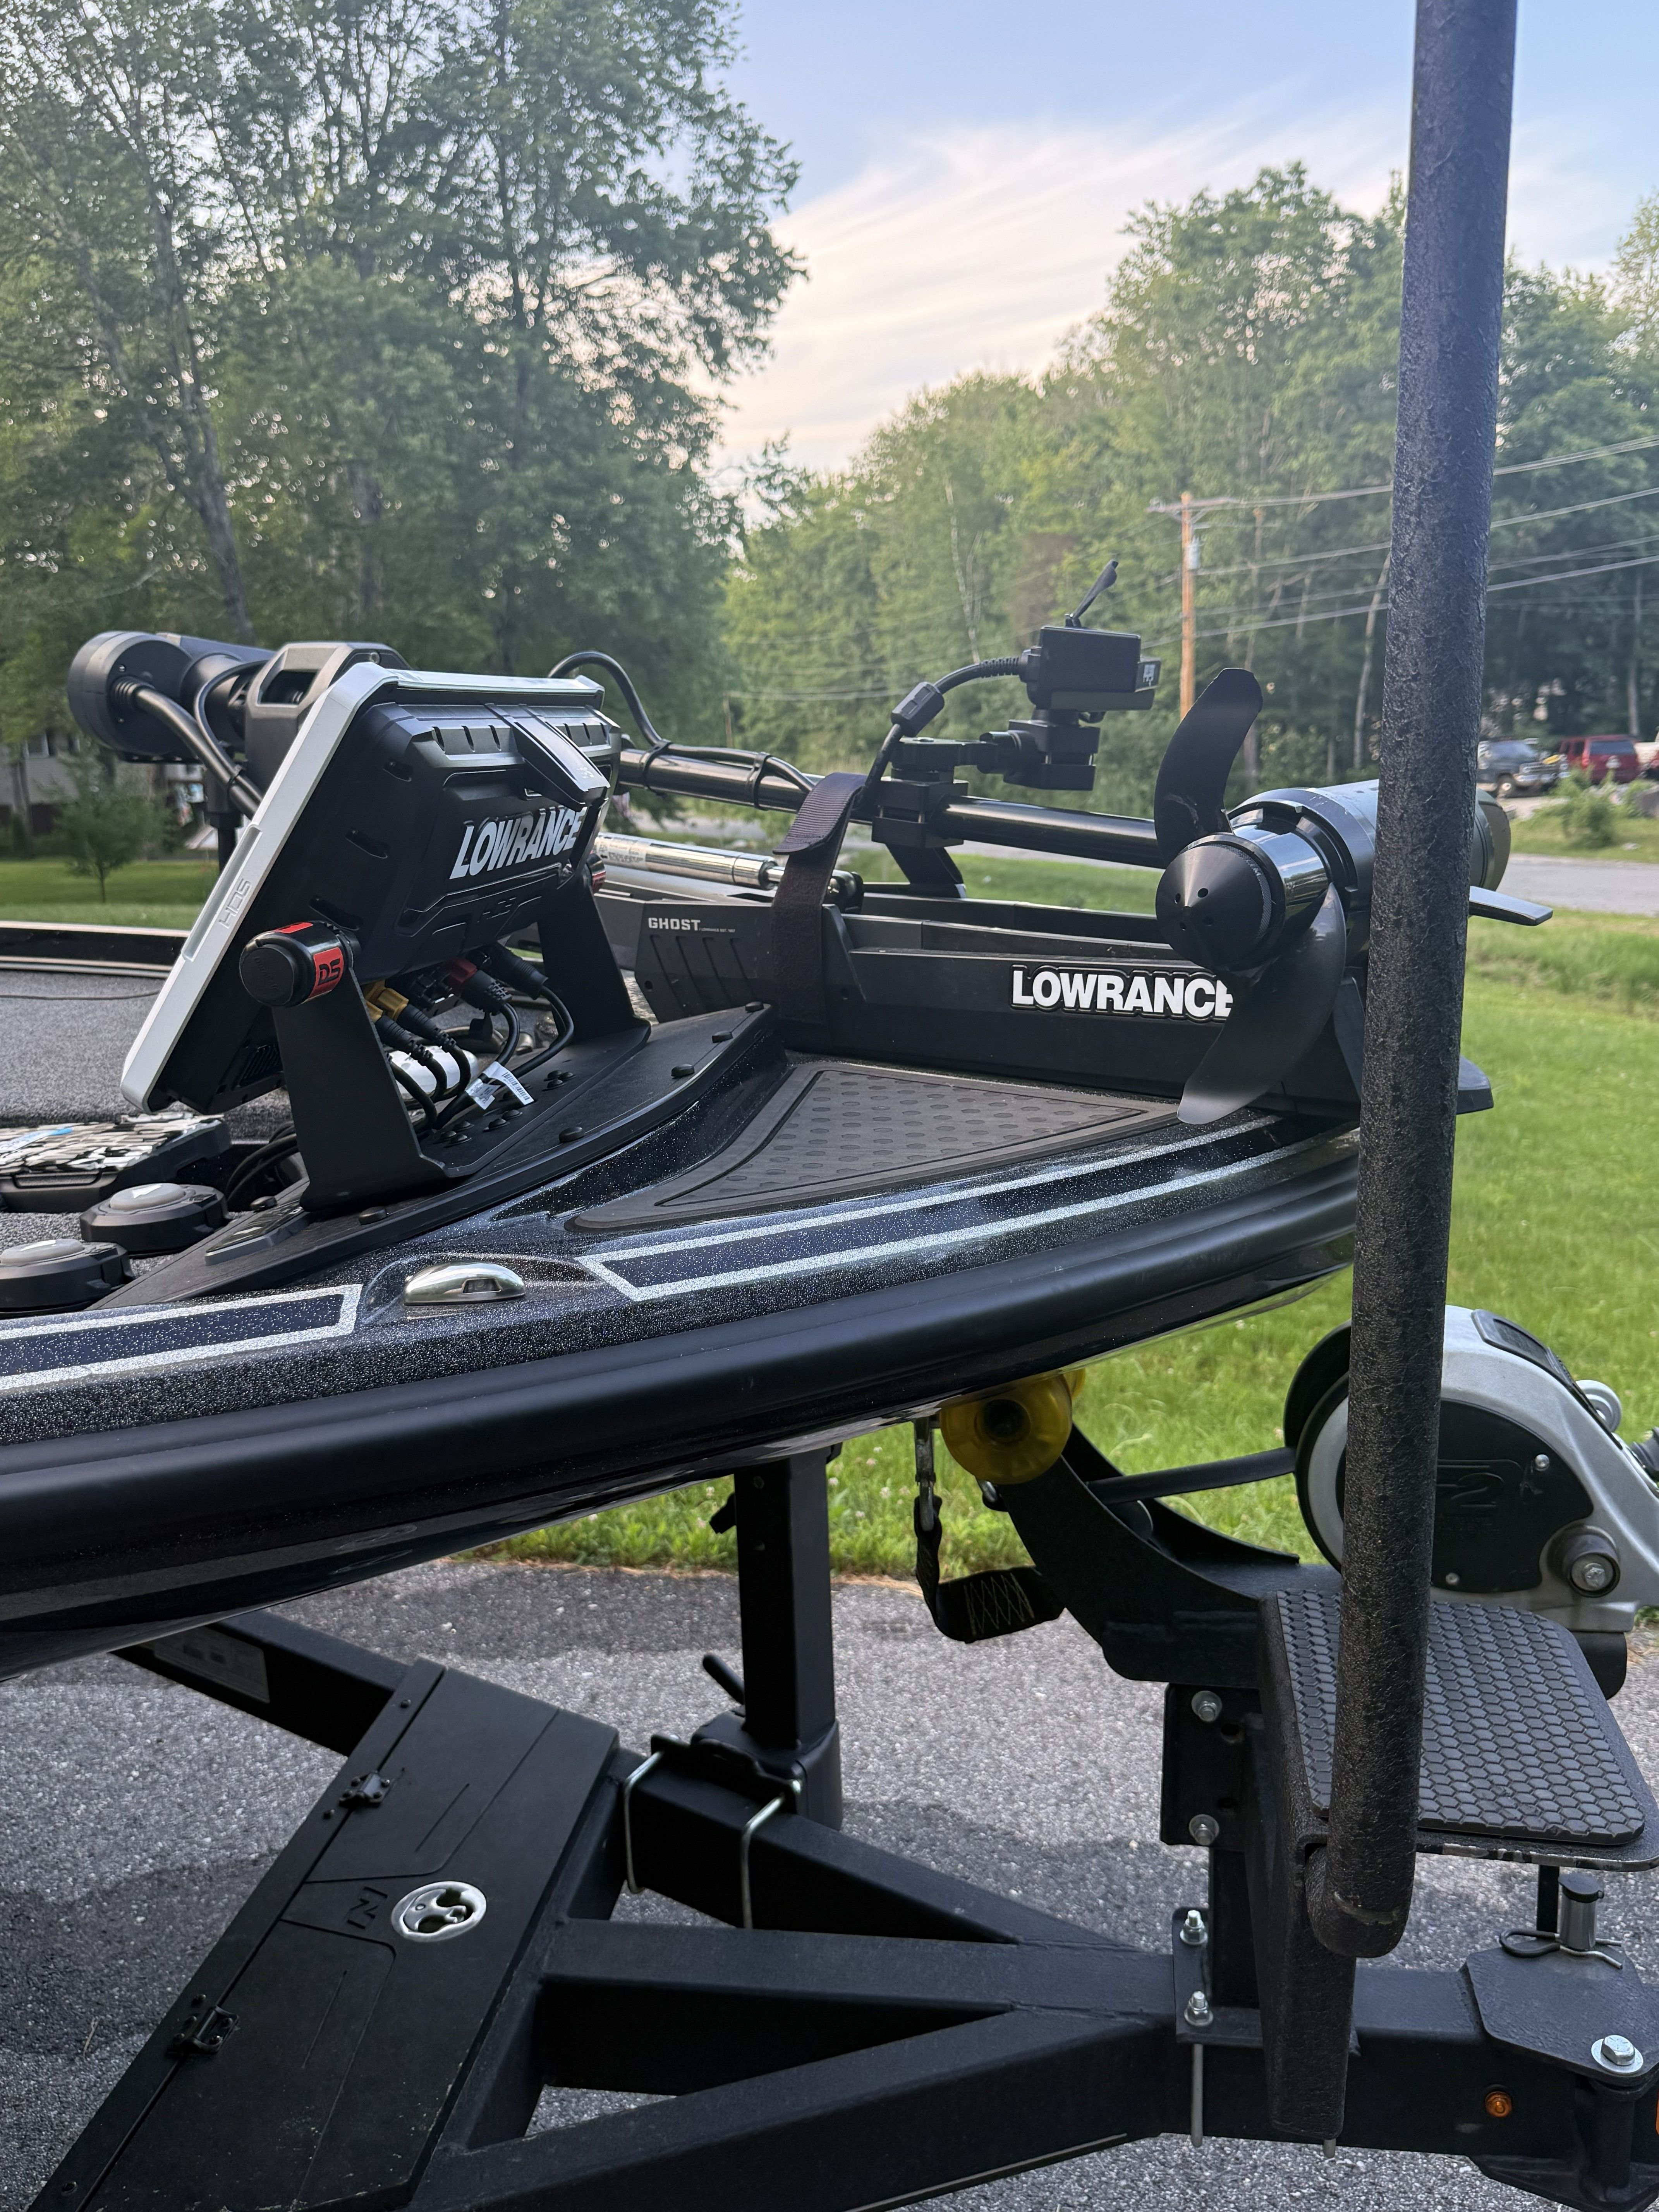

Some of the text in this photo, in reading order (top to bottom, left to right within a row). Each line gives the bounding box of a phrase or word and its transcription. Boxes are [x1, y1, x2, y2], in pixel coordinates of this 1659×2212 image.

[449, 805, 587, 879] LOWRANCE
[219, 878, 251, 929] HDS
[648, 917, 701, 931] GHOST
[1013, 970, 1233, 1017] LOWRANCE
